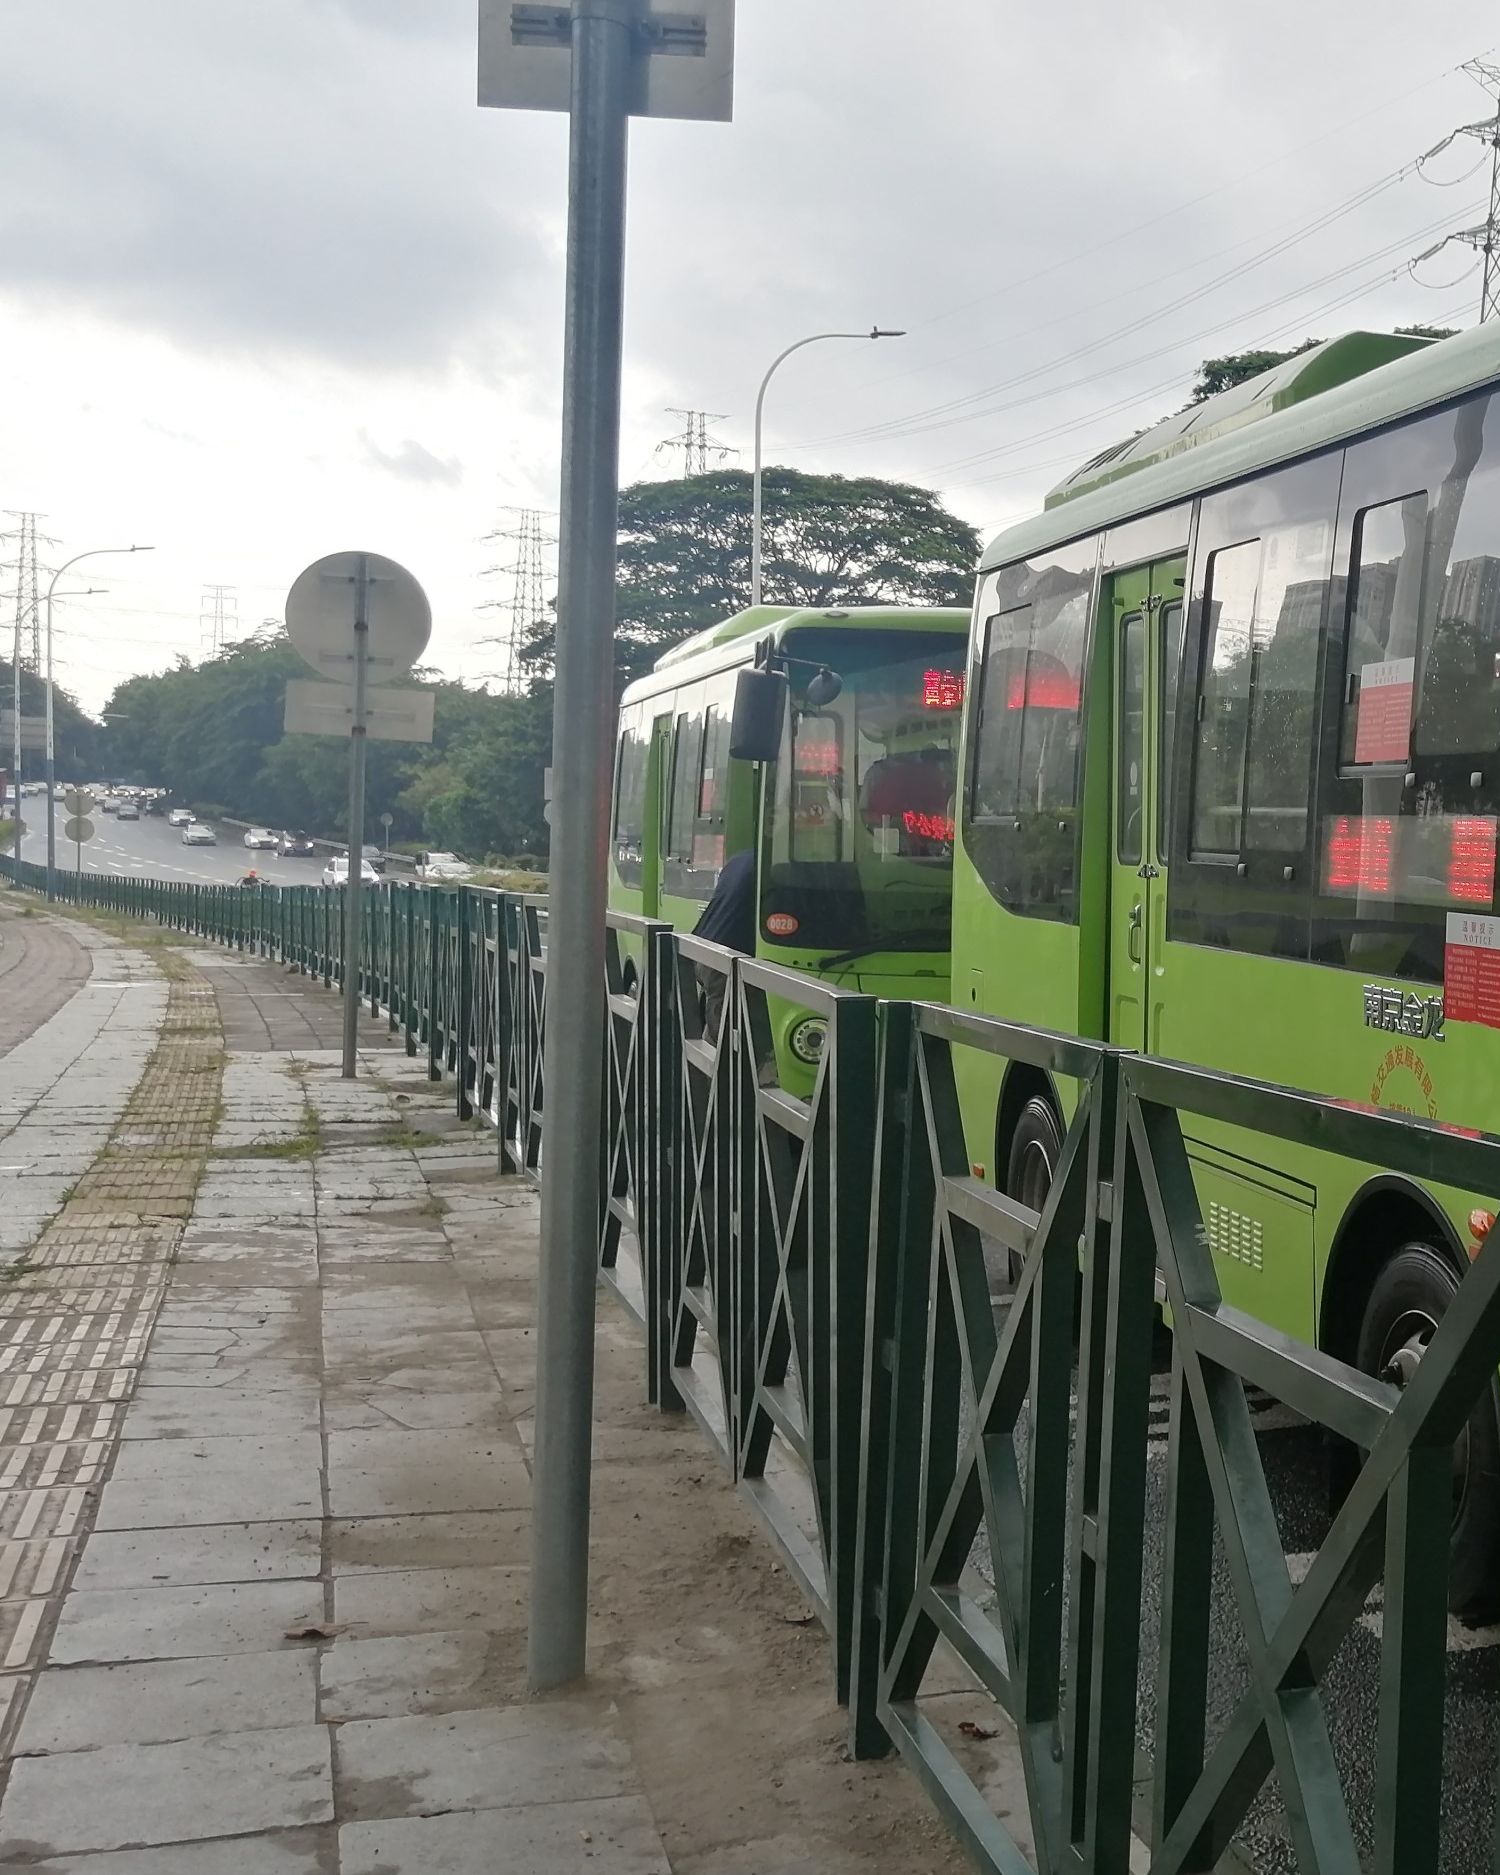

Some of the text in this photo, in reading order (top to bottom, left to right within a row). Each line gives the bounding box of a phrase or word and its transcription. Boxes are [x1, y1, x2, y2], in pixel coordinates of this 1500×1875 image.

[769, 916, 794, 931] 0028
[1463, 934, 1493, 946] NOTICE
[1362, 983, 1446, 1043] 南京金龙
